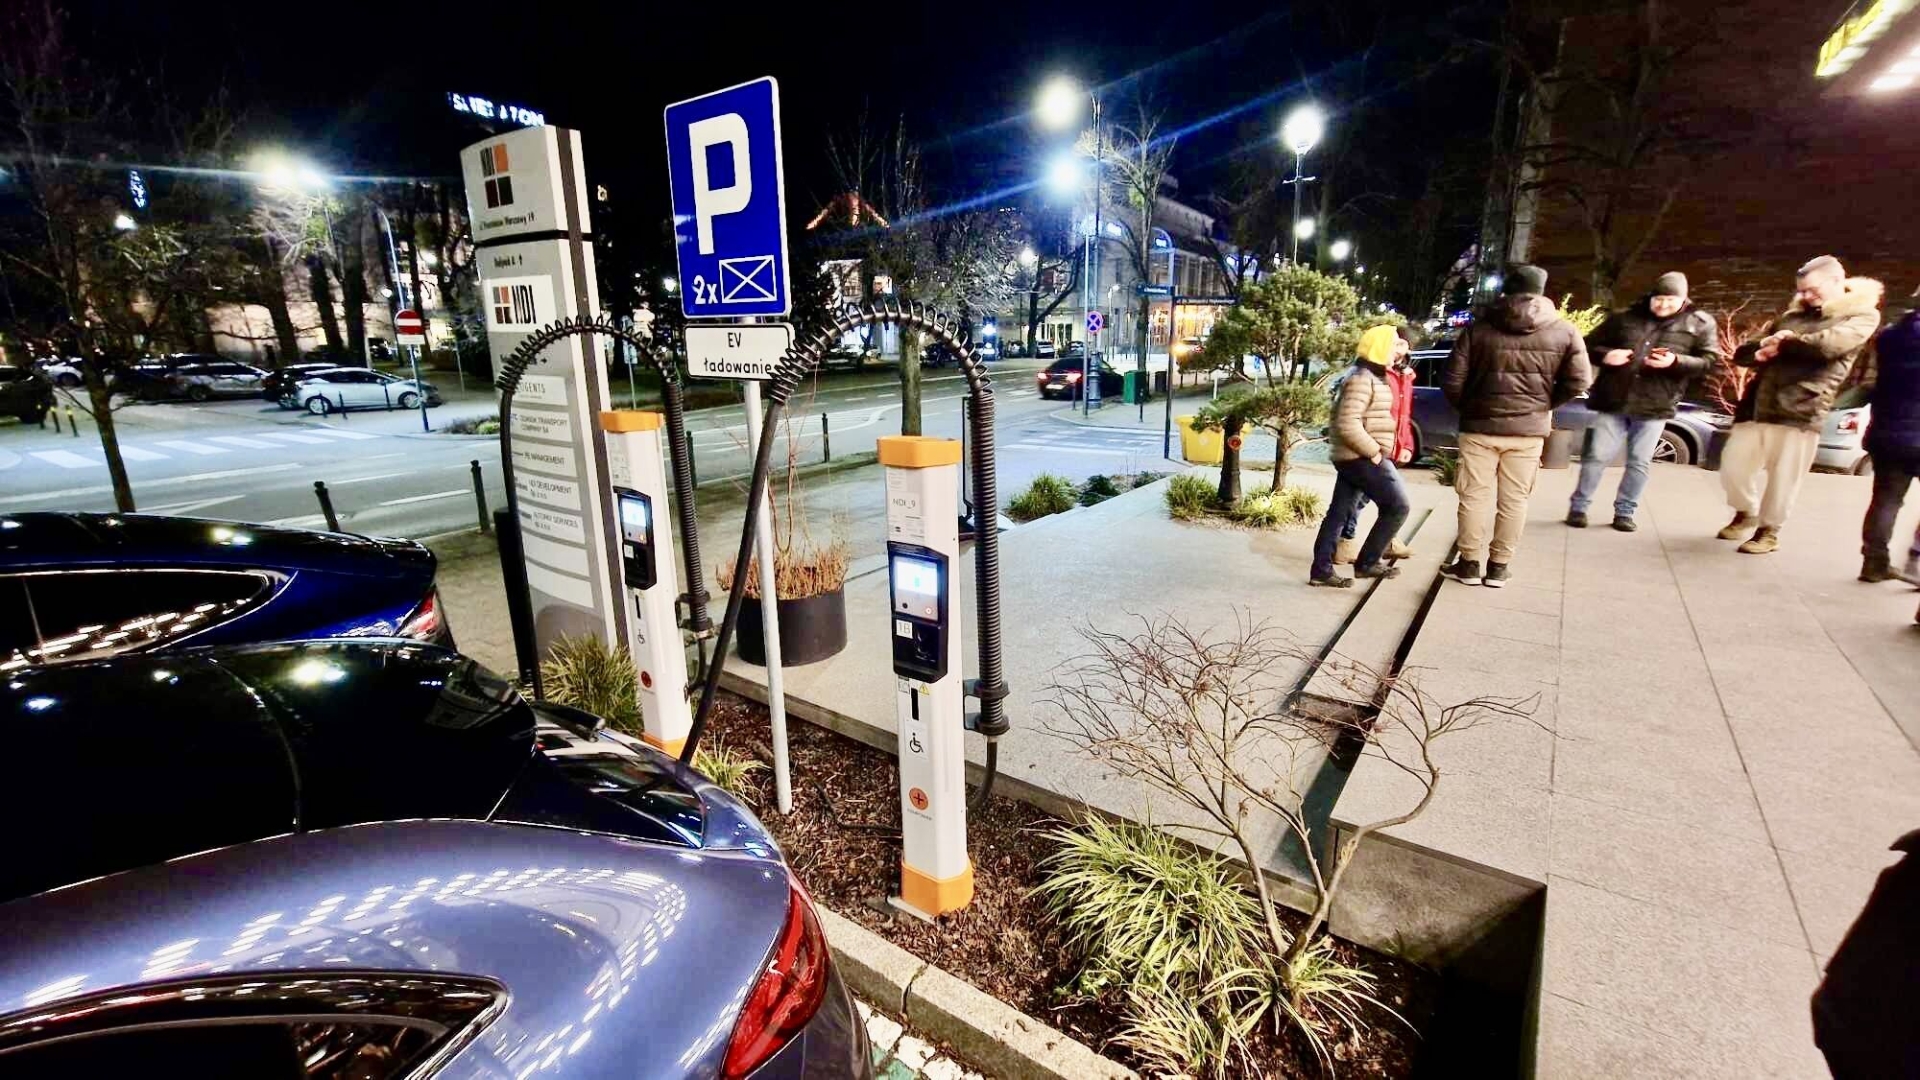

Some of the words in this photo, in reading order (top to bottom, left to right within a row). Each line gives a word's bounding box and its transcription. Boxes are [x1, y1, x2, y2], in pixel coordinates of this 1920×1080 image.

[688, 112, 752, 255] P
[692, 274, 719, 305] 2x
[727, 332, 742, 348] EV
[703, 357, 772, 375] ładowanie
